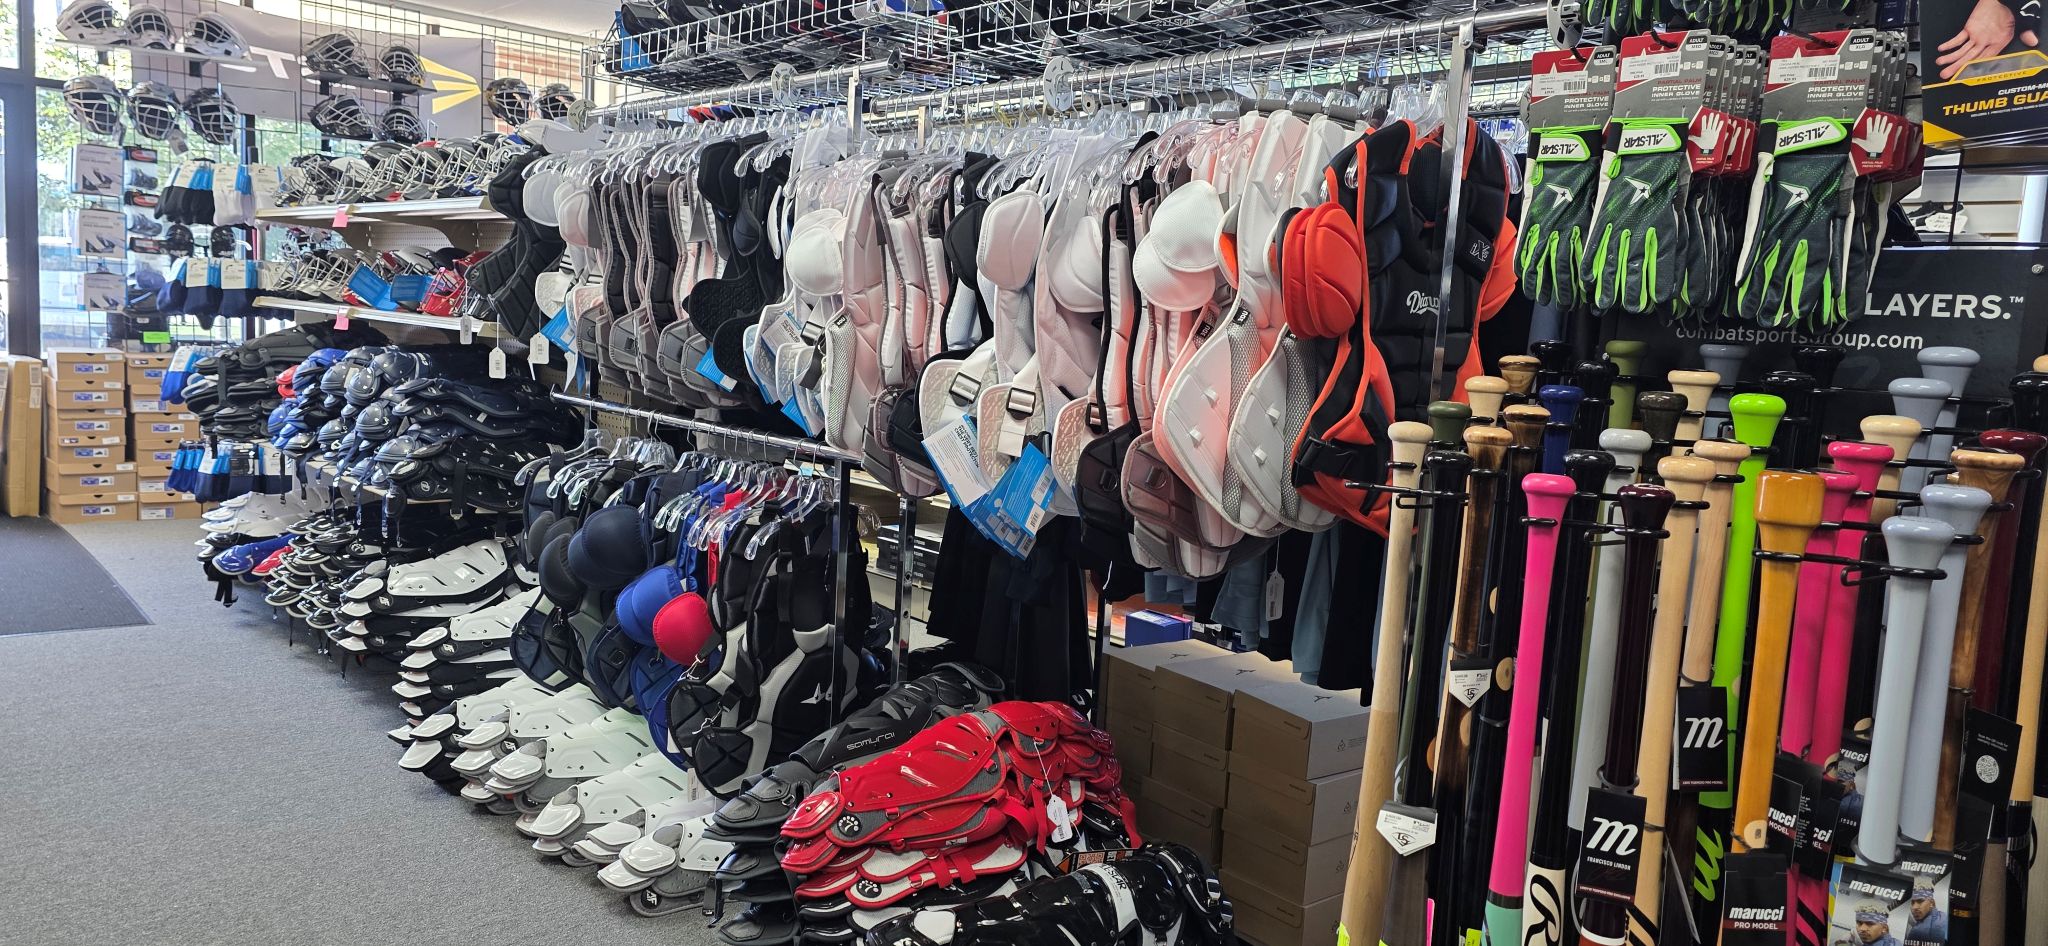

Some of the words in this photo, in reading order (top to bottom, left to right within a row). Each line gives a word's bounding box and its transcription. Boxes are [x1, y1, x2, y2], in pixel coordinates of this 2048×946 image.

[1652, 84, 1701, 92] PROTECTIVE
[1564, 96, 1609, 104] PROTECTIVE
[1942, 97, 2008, 116] THUMB
[1624, 133, 1668, 148] ALL-STAR
[1779, 124, 1830, 148] ALL-STAR
[1541, 143, 1580, 155] ALL-STAR
[846, 731, 895, 751] samurai
[1839, 748, 1869, 763] rucci
[1768, 820, 1790, 836] MODEL
[1587, 856, 1613, 867] FRANCISCO
[1900, 860, 1947, 875] marucci
[1849, 880, 1906, 901] marucci
[1729, 905, 1785, 921] marucci
[1734, 921, 1751, 929] PRO
[1751, 922, 1779, 930] MODEL
